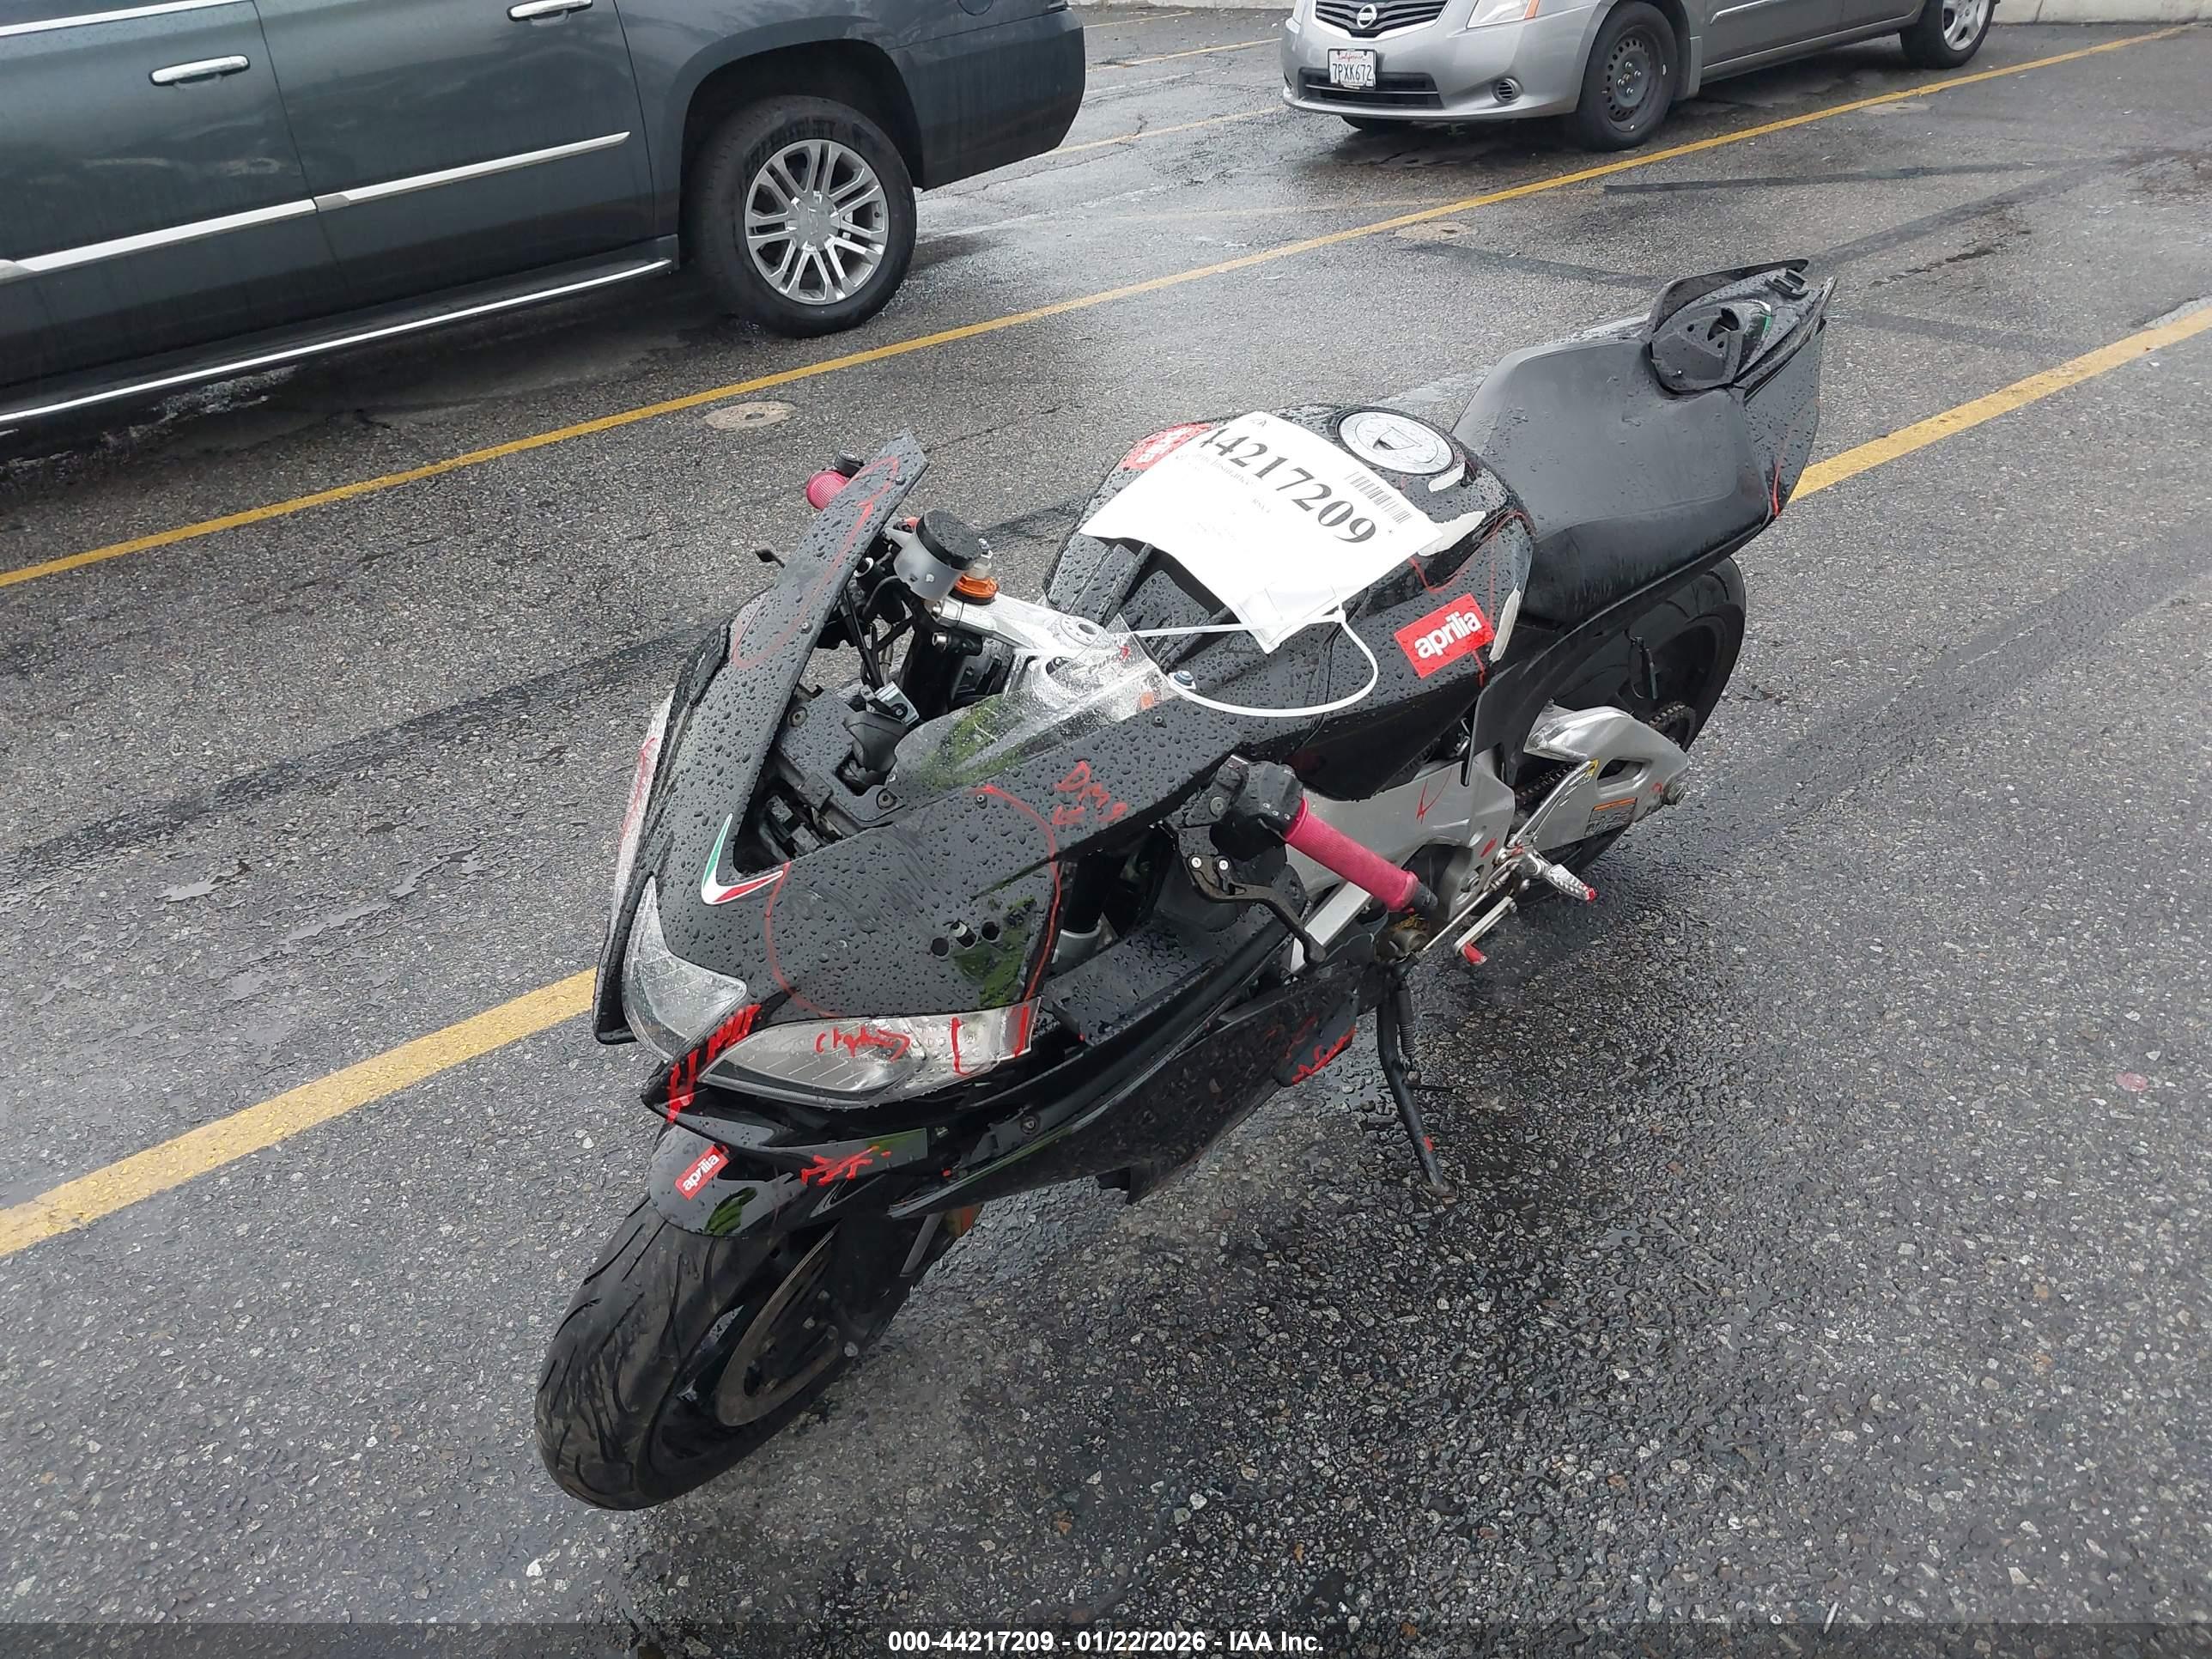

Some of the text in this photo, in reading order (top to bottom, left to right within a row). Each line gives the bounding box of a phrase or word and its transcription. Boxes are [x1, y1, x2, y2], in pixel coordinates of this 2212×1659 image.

[1332, 63, 1372, 82] 7PXK672
[1414, 611, 1483, 659] aprilia
[683, 1154, 720, 1192] aprilia
